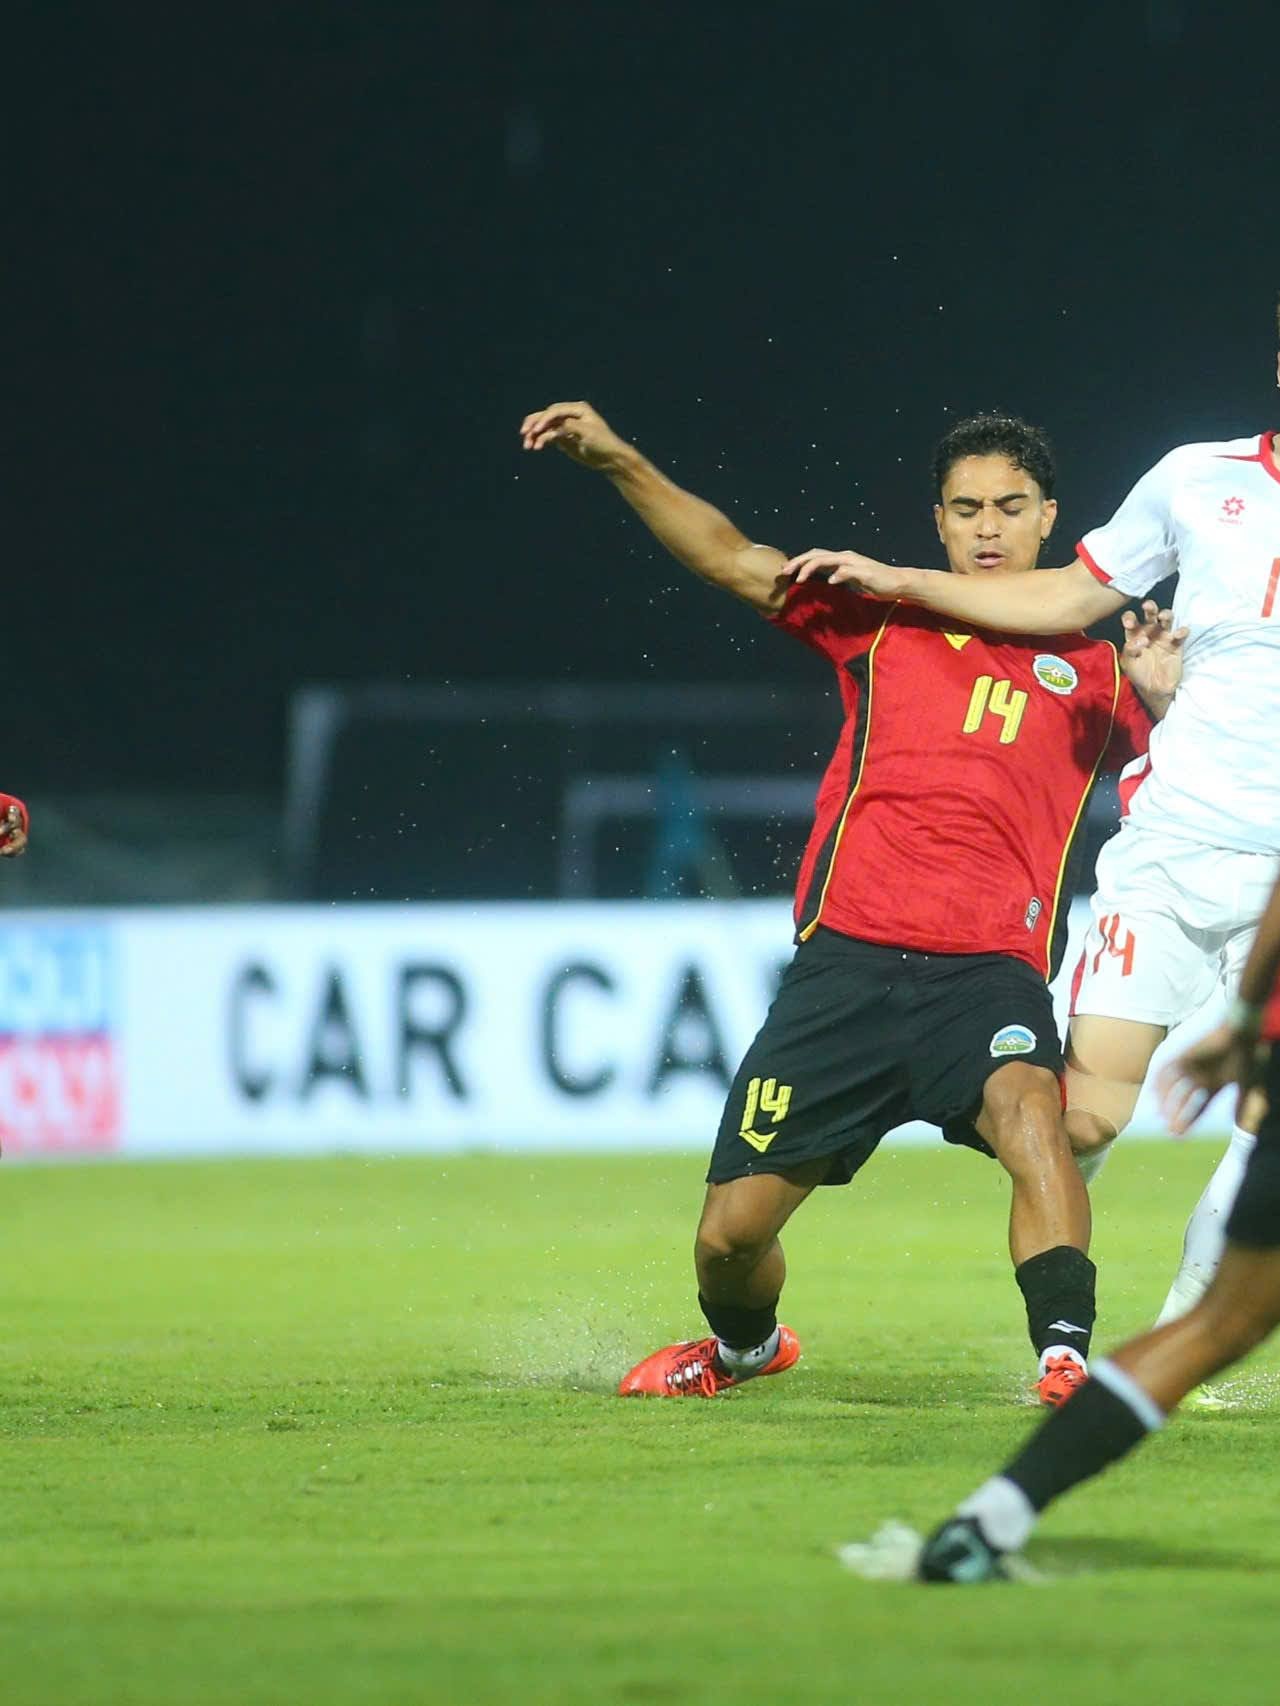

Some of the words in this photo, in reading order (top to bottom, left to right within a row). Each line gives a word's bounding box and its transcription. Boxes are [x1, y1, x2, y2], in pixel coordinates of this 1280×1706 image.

[962, 675, 1028, 744] 14
[1092, 912, 1136, 977] 14
[228, 958, 470, 1104] CAR
[540, 958, 790, 1102] CA
[741, 1078, 792, 1131] 14
